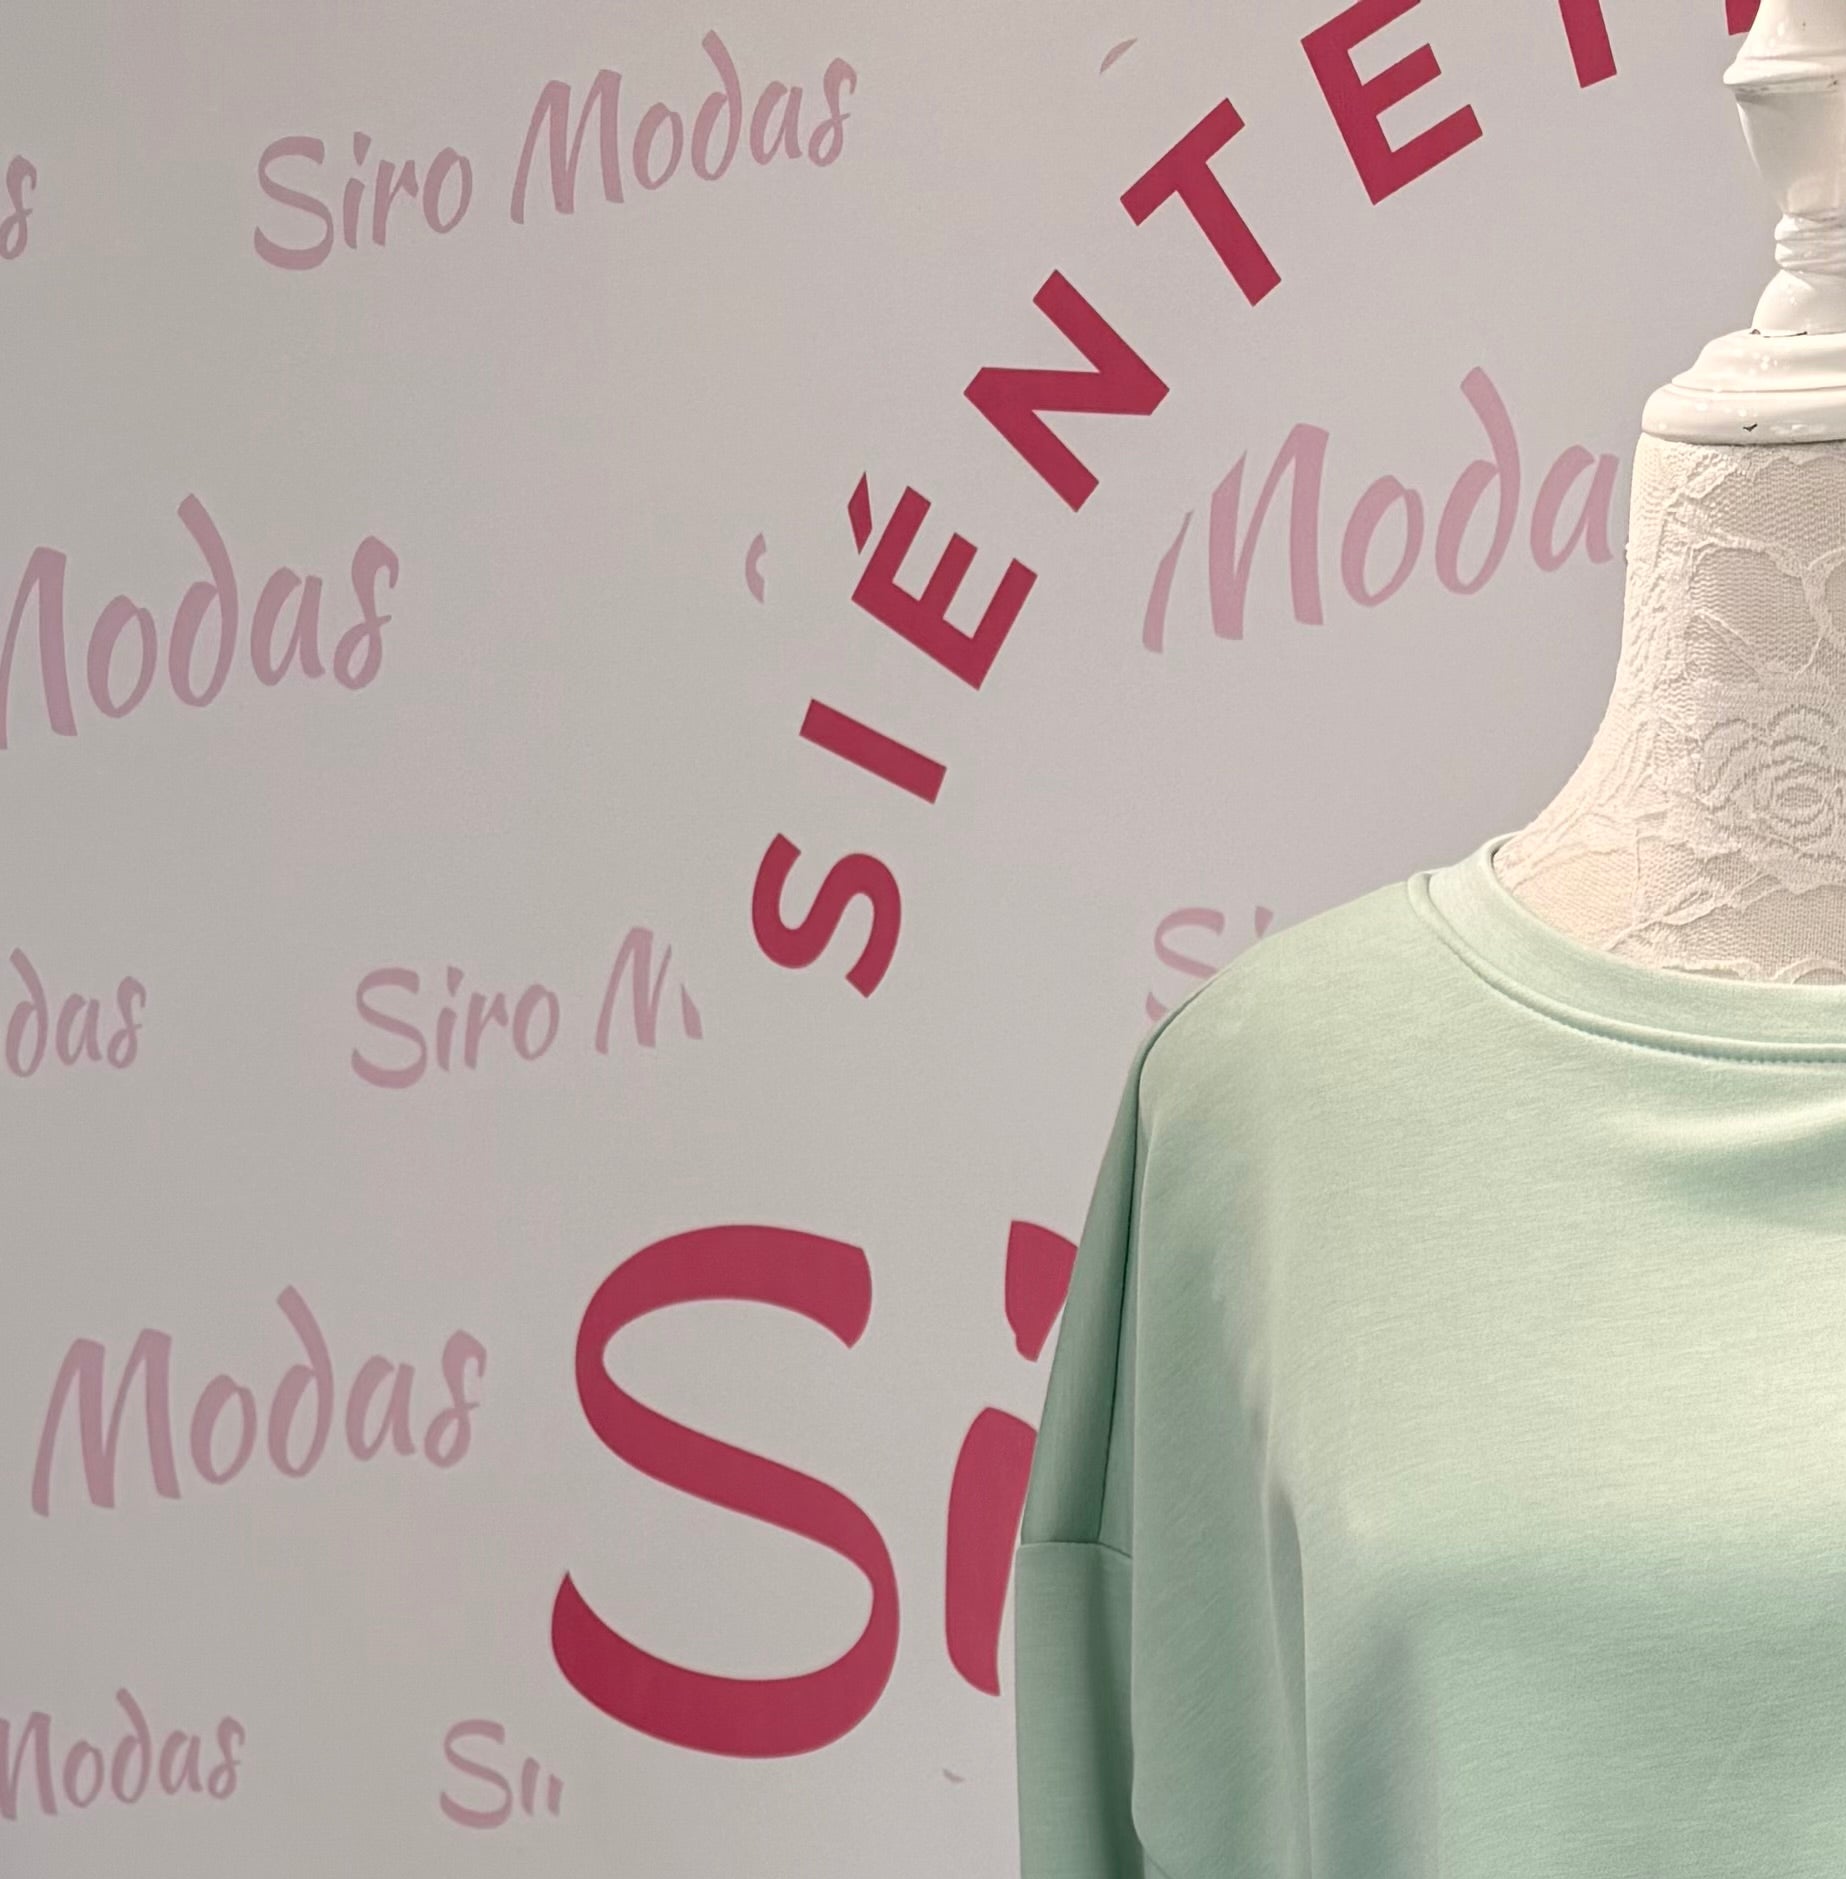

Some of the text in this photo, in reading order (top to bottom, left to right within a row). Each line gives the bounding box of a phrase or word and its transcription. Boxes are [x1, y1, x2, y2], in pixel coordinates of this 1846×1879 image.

[252, 32, 857, 271] Siro Modas
[1142, 366, 1621, 654] Moda
[3, 951, 147, 1076] das
[351, 967, 559, 1090] Siro
[31, 1288, 487, 1514] Modas
[552, 1222, 1078, 1758] Si
